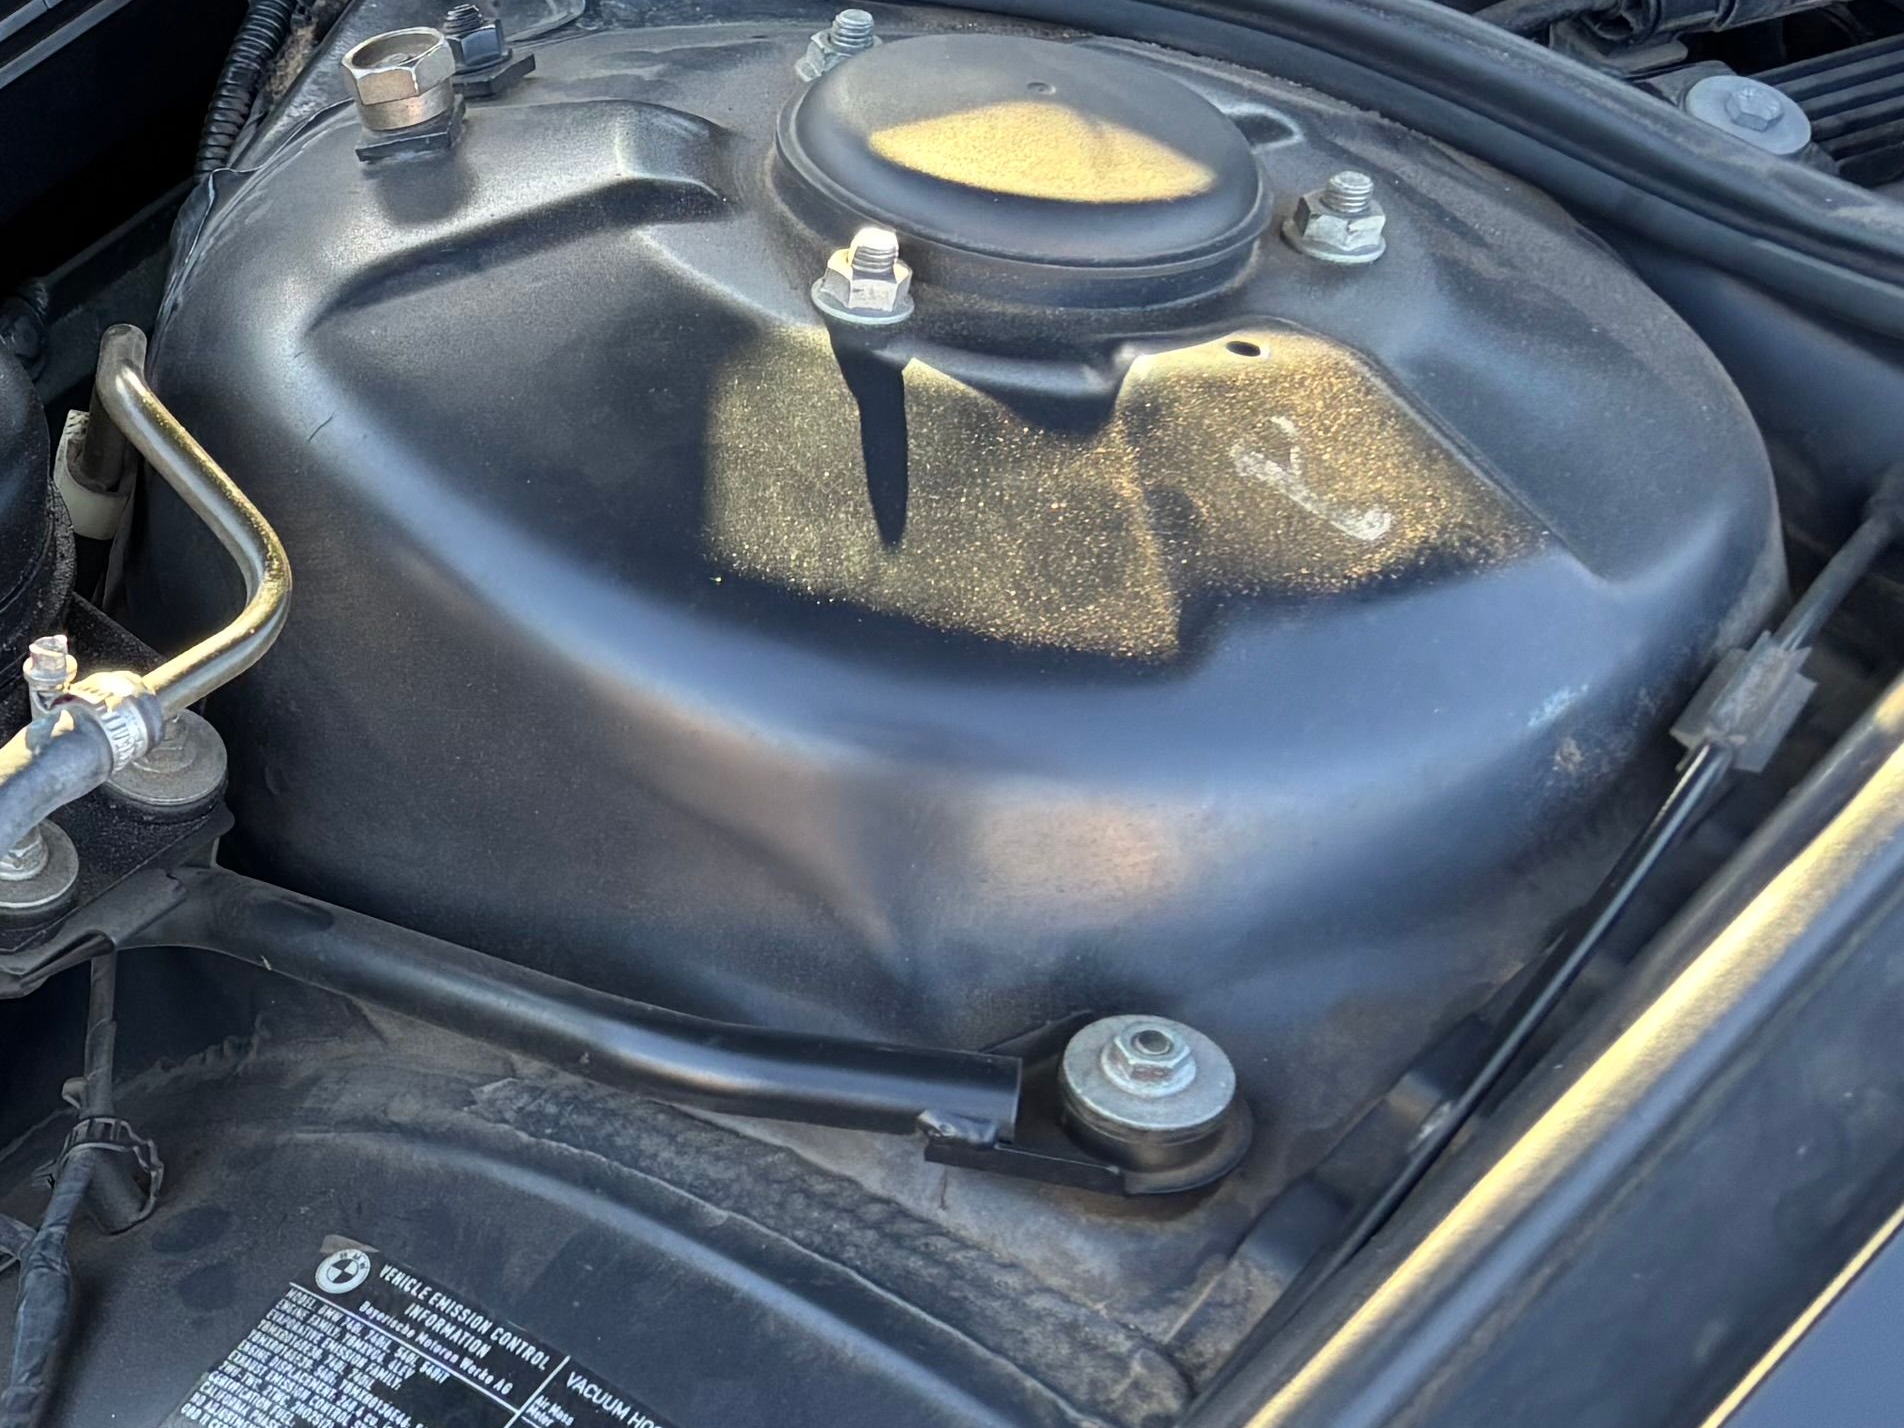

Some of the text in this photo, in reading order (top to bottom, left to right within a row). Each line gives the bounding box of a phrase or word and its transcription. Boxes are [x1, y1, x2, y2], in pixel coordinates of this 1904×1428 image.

[377, 1263, 553, 1371] VEHICLE EMISSION CONTROL
[403, 1301, 491, 1359] INFORMATION
[320, 1335, 368, 1370] EMISSION
[357, 1298, 514, 1395] Bayerische Motoren Werke AG
[265, 1367, 311, 1401] EMISSION
[307, 1393, 353, 1426] CONTROL
[523, 1404, 555, 1428] Meter
[531, 1393, 576, 1427] Air Mass
[561, 1372, 632, 1421] VACUUM
